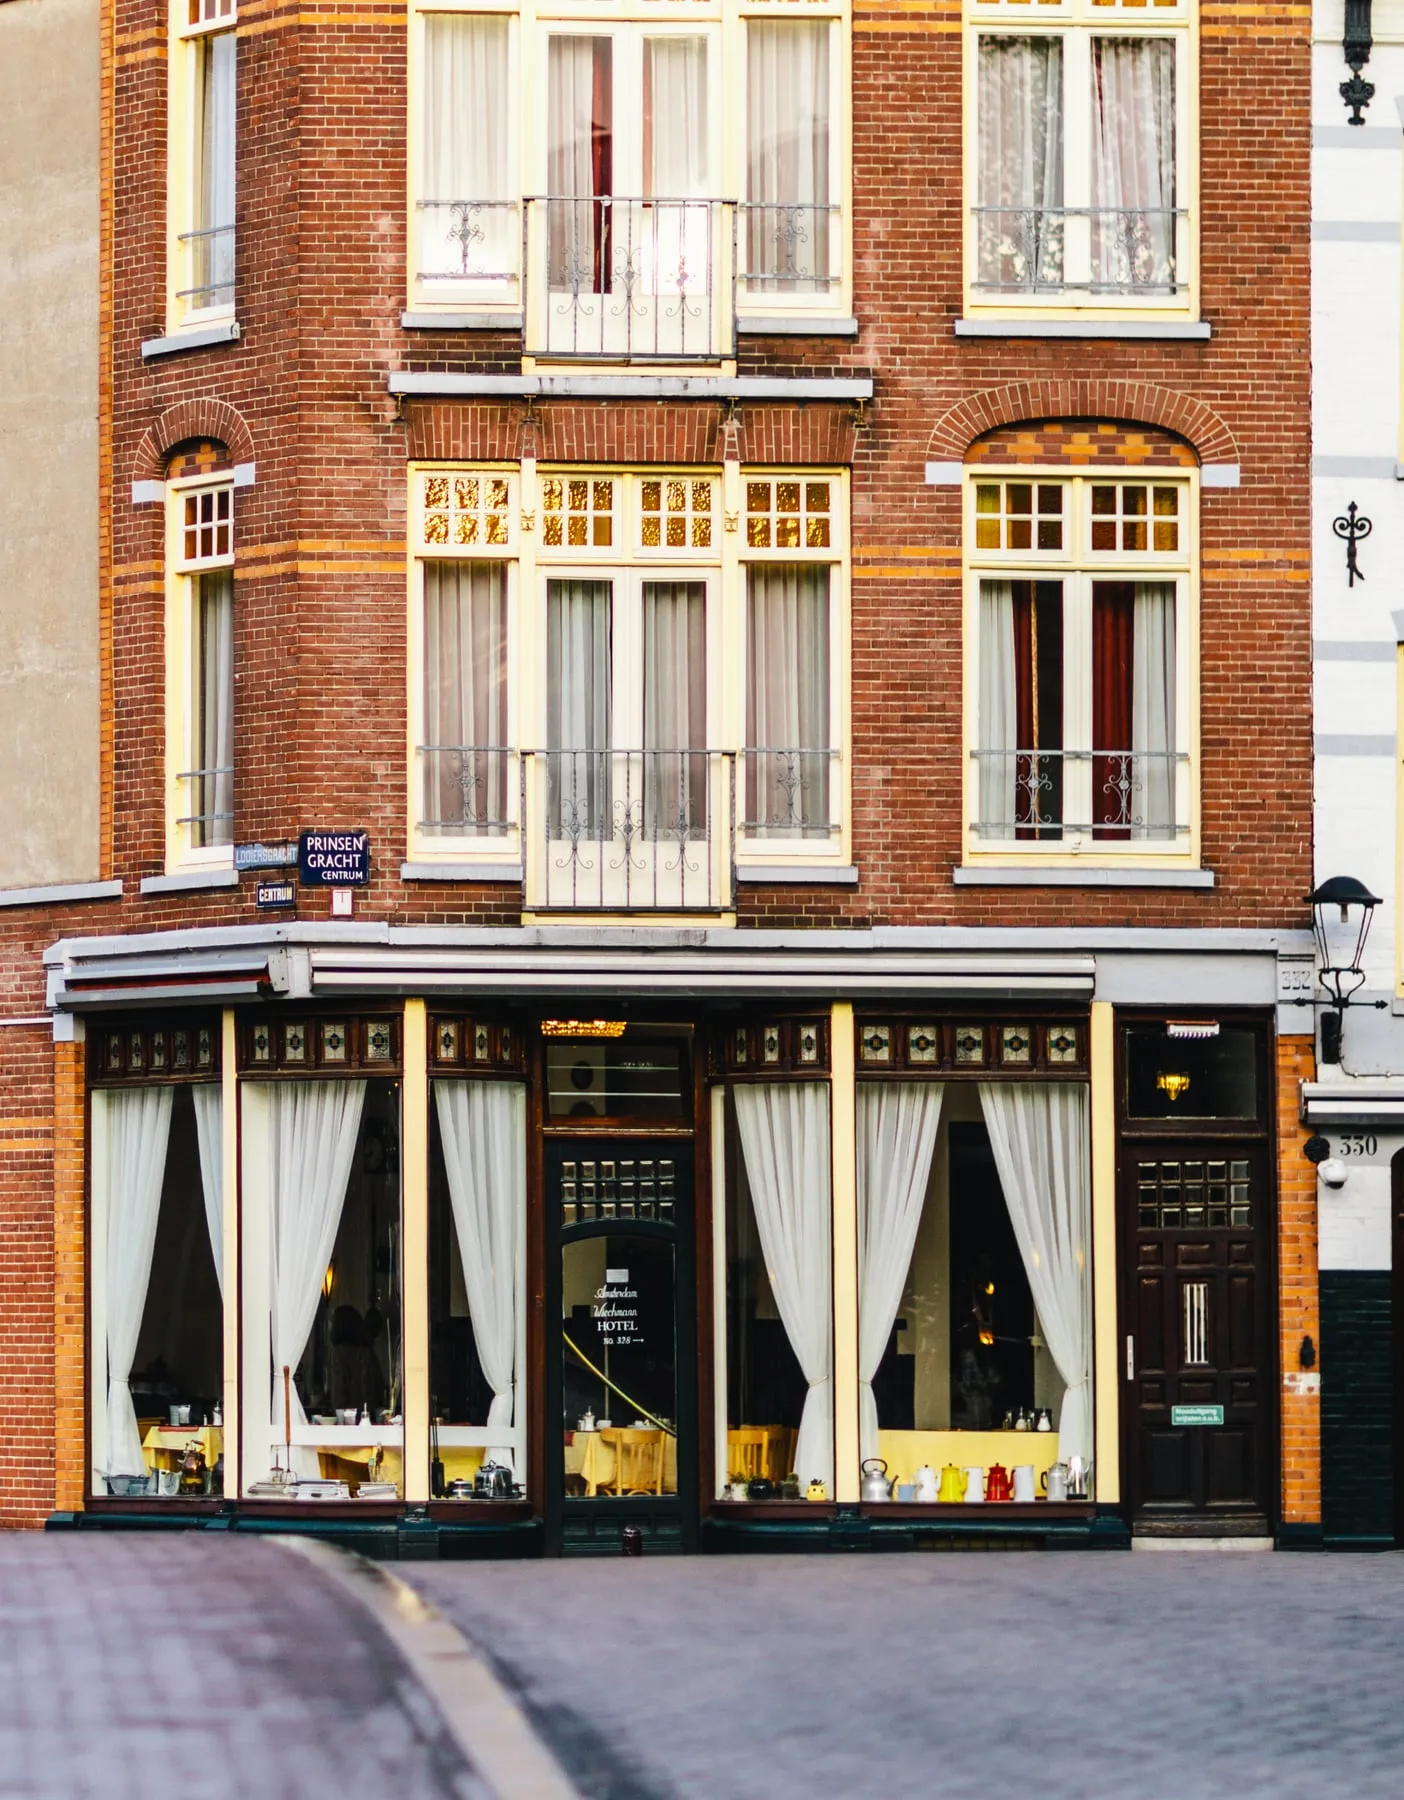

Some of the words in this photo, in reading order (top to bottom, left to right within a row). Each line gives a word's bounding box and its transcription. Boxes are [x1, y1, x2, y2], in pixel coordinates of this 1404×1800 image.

[307, 836, 363, 851] PRINSEN
[307, 853, 362, 868] GRACHT
[321, 871, 363, 880] CENTRUM
[259, 886, 293, 902] CENTRUM
[1282, 970, 1311, 990] 332
[1339, 1135, 1378, 1156] 330
[597, 1321, 638, 1331] HOTEL
